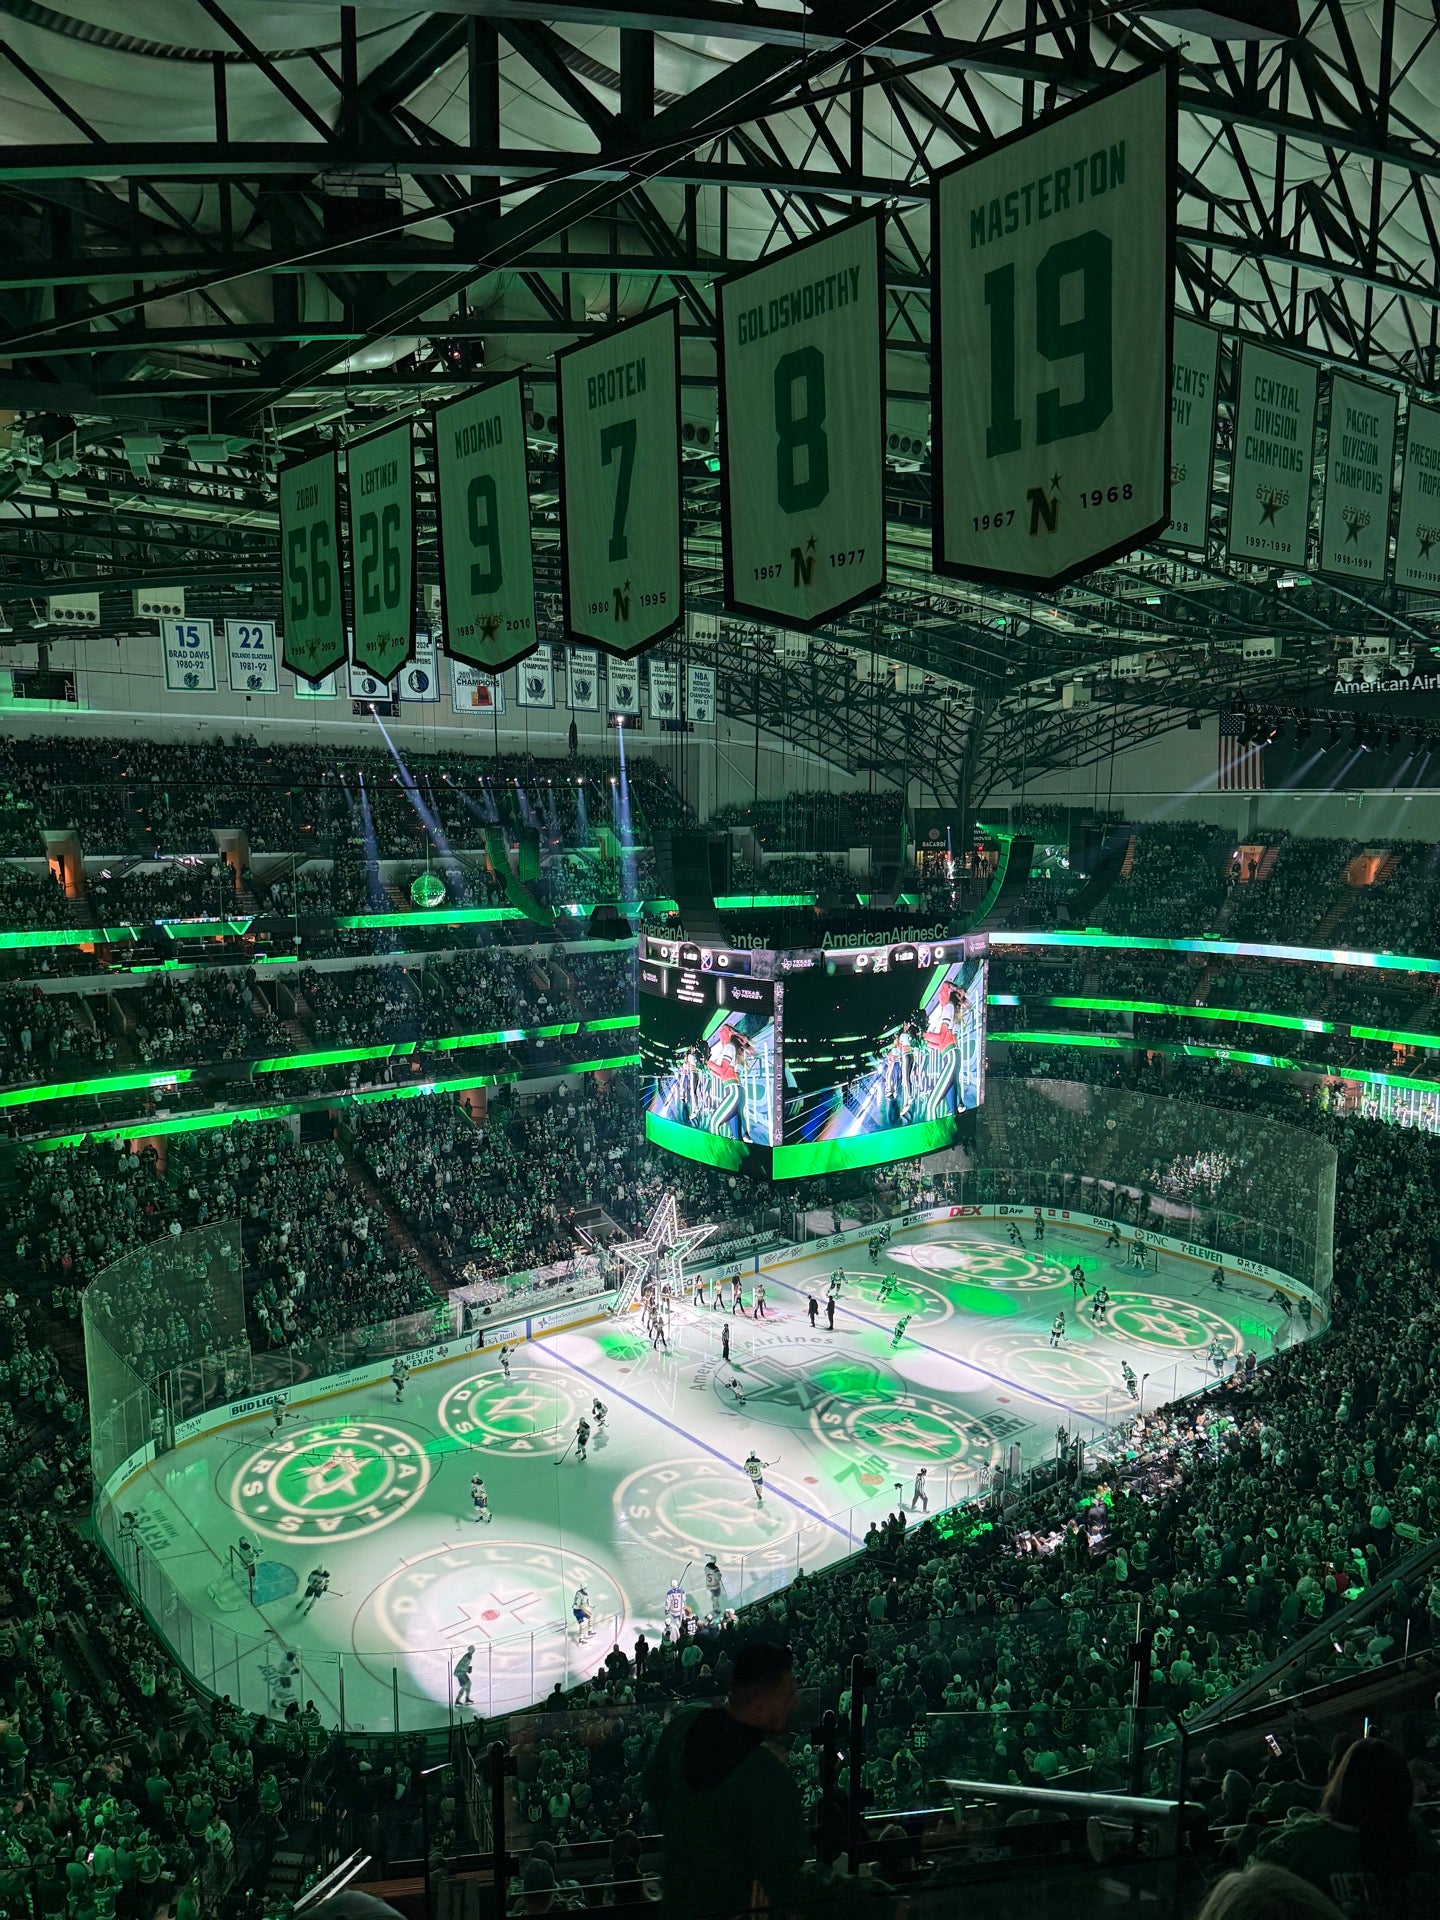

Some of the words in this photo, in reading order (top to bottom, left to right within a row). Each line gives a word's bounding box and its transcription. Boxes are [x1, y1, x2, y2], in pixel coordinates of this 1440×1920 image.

[970, 140, 1126, 249] MASTERTON
[737, 265, 861, 346] GOLDSWORTHY
[984, 229, 1113, 459] 19
[587, 357, 647, 410] BROTEN
[1254, 375, 1300, 413] CENTRAL
[773, 345, 830, 514] 8
[1254, 407, 1297, 442] DIVISION
[1346, 407, 1379, 439] PACIFIC
[454, 415, 503, 460] MODANO
[1244, 436, 1304, 473] CHAMPIONS
[1341, 434, 1379, 467] DIVISION
[360, 460, 398, 496] LEHTINEN
[1334, 460, 1383, 495] CHAMPIONS
[600, 418, 637, 564] 7
[1079, 483, 1134, 510] 1968
[1255, 486, 1290, 506] STARS
[972, 508, 1016, 533] 1967
[1026, 485, 1061, 538] N
[1341, 507, 1372, 526] STARS
[467, 474, 503, 596] 9
[1245, 535, 1292, 553] 1997-1998
[359, 503, 401, 615] 26
[790, 545, 817, 588] N
[829, 548, 866, 568] 1977
[288, 520, 331, 622] 56
[753, 564, 783, 581] 1967
[588, 600, 610, 616] 1980
[613, 587, 630, 622] N
[639, 591, 667, 608] 1995
[474, 614, 504, 627] STARS
[506, 617, 531, 631] 2010
[175, 625, 200, 648] 15
[238, 626, 264, 649] 22
[456, 625, 475, 638] 1989
[321, 641, 336, 652] 2009
[416, 641, 430, 650] 2024
[168, 650, 188, 659] BRAD
[189, 651, 210, 660] DAVIS
[231, 652, 251, 660] ROLANDO
[251, 653, 273, 661] BLACKMAN
[176, 660, 204, 669] 1980-92
[239, 661, 267, 672] 1981-92
[522, 662, 549, 671] CHAMPIONS
[570, 667, 595, 676] CHAMPIONS
[456, 677, 501, 688] CHAMPIONS
[611, 672, 636, 681] CHAMPIONS
[694, 671, 708, 681] NBA
[1333, 677, 1409, 695] American
[689, 692, 714, 700] CHAMPIONS
[921, 839, 946, 848] BACARDÍ
[660, 946, 669, 958] 0
[717, 954, 729, 967] 0
[856, 954, 869, 967] 0
[934, 947, 944, 959] 0
[949, 1205, 984, 1218] DEX
[1146, 1232, 1168, 1248] PNC
[725, 1263, 743, 1275] AT&T
[500, 1330, 517, 1342] Bank
[745, 1335, 834, 1349] Airlines
[405, 1351, 424, 1362] BEST
[425, 1348, 434, 1357] IN
[231, 1402, 254, 1416] BUD
[748, 1465, 758, 1475] 89
[276, 1443, 418, 1532] DALLAS
[392, 1549, 595, 1615] DALLAS
[308, 1735, 318, 1746] 21
[914, 1736, 927, 1748] 95
